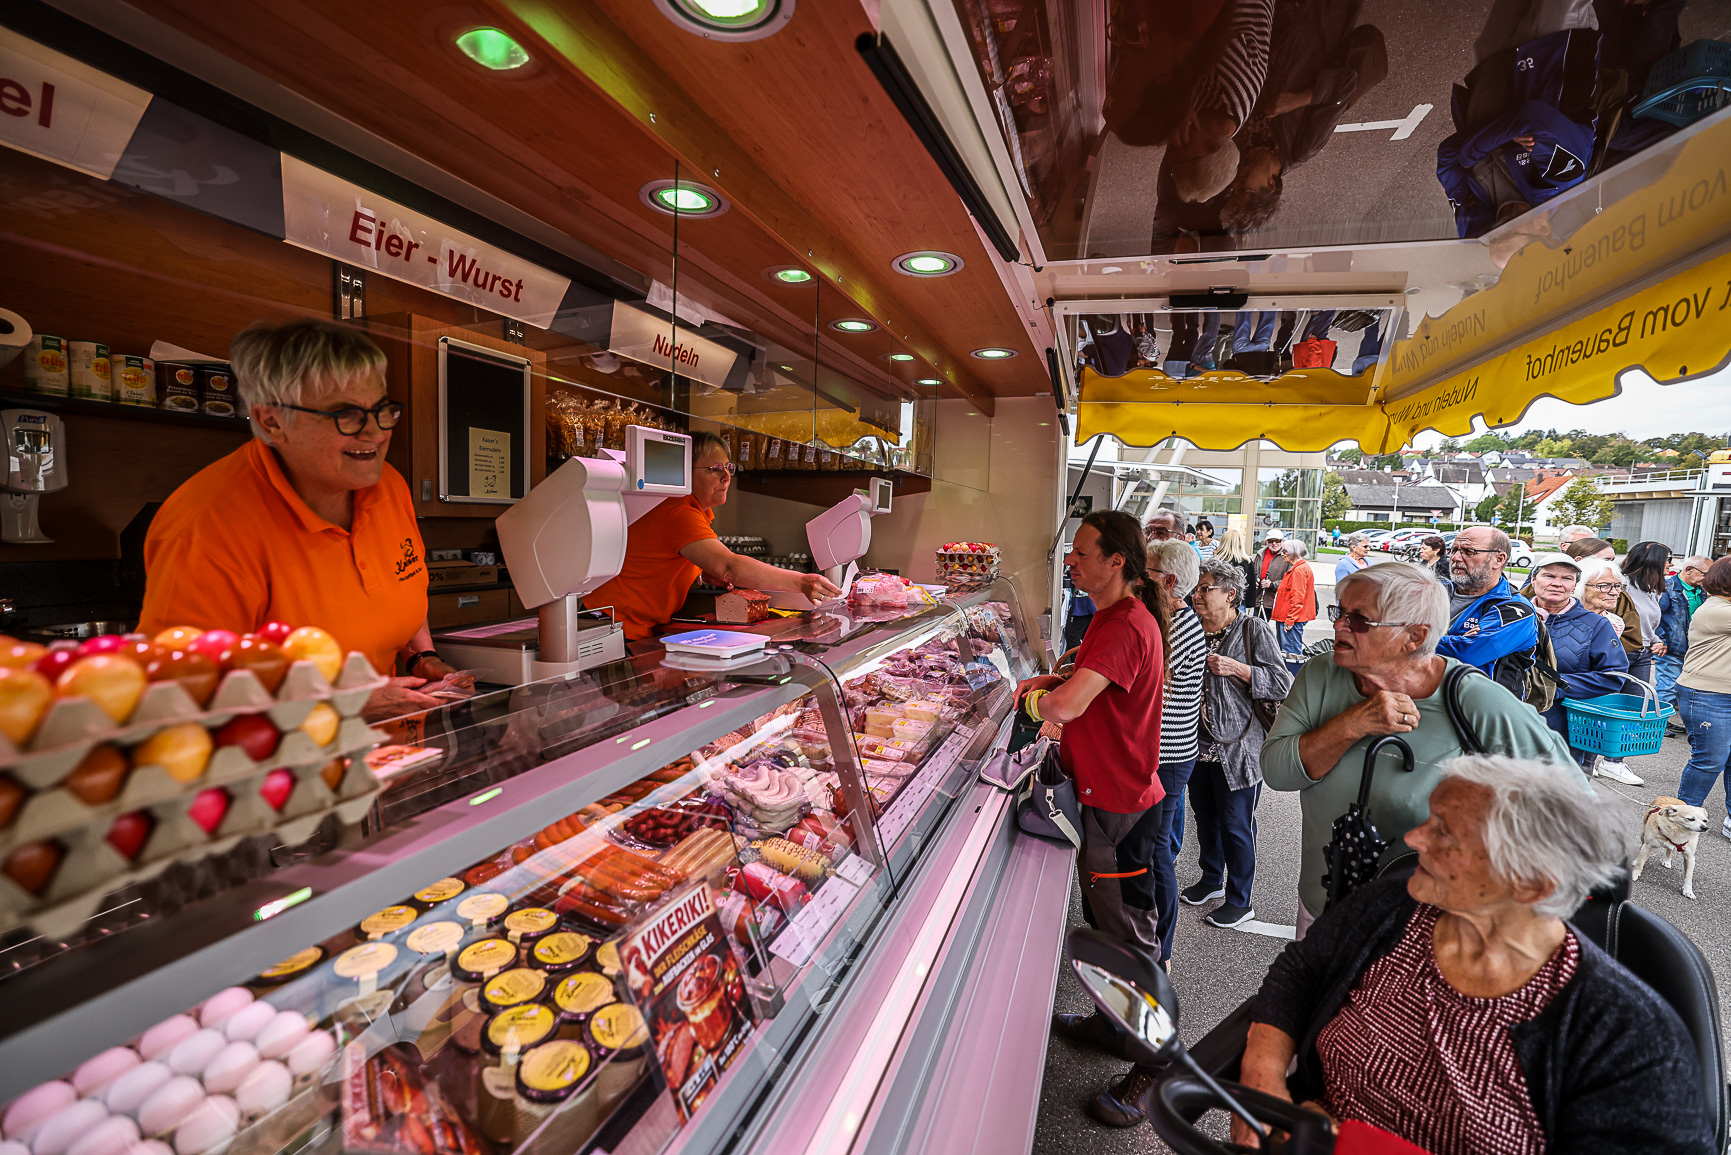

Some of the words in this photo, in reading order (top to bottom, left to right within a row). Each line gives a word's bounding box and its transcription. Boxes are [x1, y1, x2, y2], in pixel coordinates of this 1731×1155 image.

[1657, 168, 1727, 229] vom
[349, 210, 420, 262] Eier
[427, 255, 438, 265] -
[448, 249, 524, 303] Wurst
[1534, 213, 1646, 305] Bauernhof
[652, 334, 700, 368] Nudeln
[1419, 336, 1439, 364] und
[1441, 309, 1485, 351] Nudeln
[641, 886, 710, 961] KIKERIKI!
[699, 932, 715, 953] GLAS
[665, 924, 708, 969] FLEISCHKÄSE
